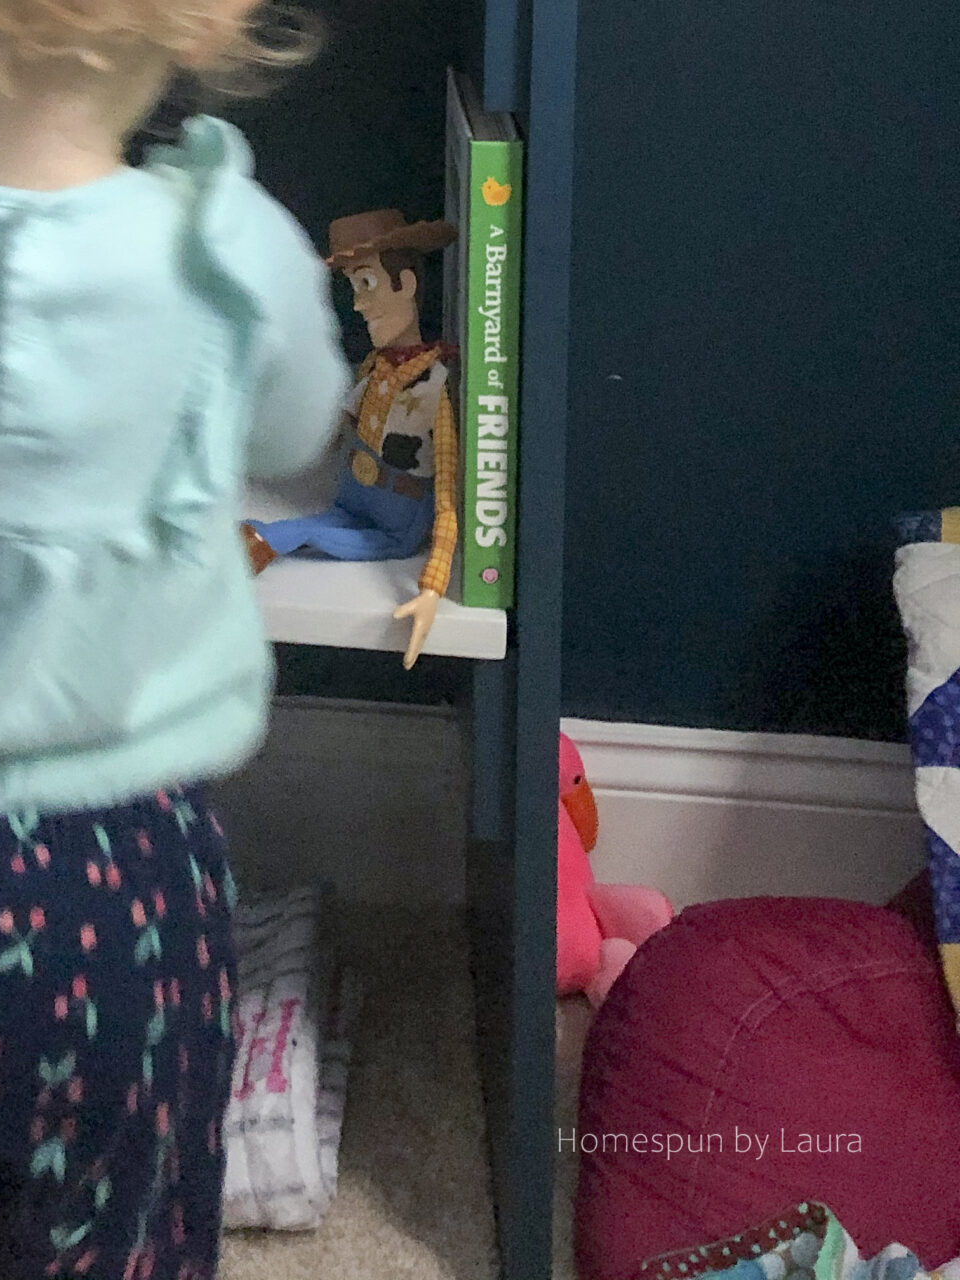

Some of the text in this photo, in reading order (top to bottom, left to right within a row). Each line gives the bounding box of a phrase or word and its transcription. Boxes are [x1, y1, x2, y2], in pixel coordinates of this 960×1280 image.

[476, 225, 508, 548] A Barnyard of FRIENDS
